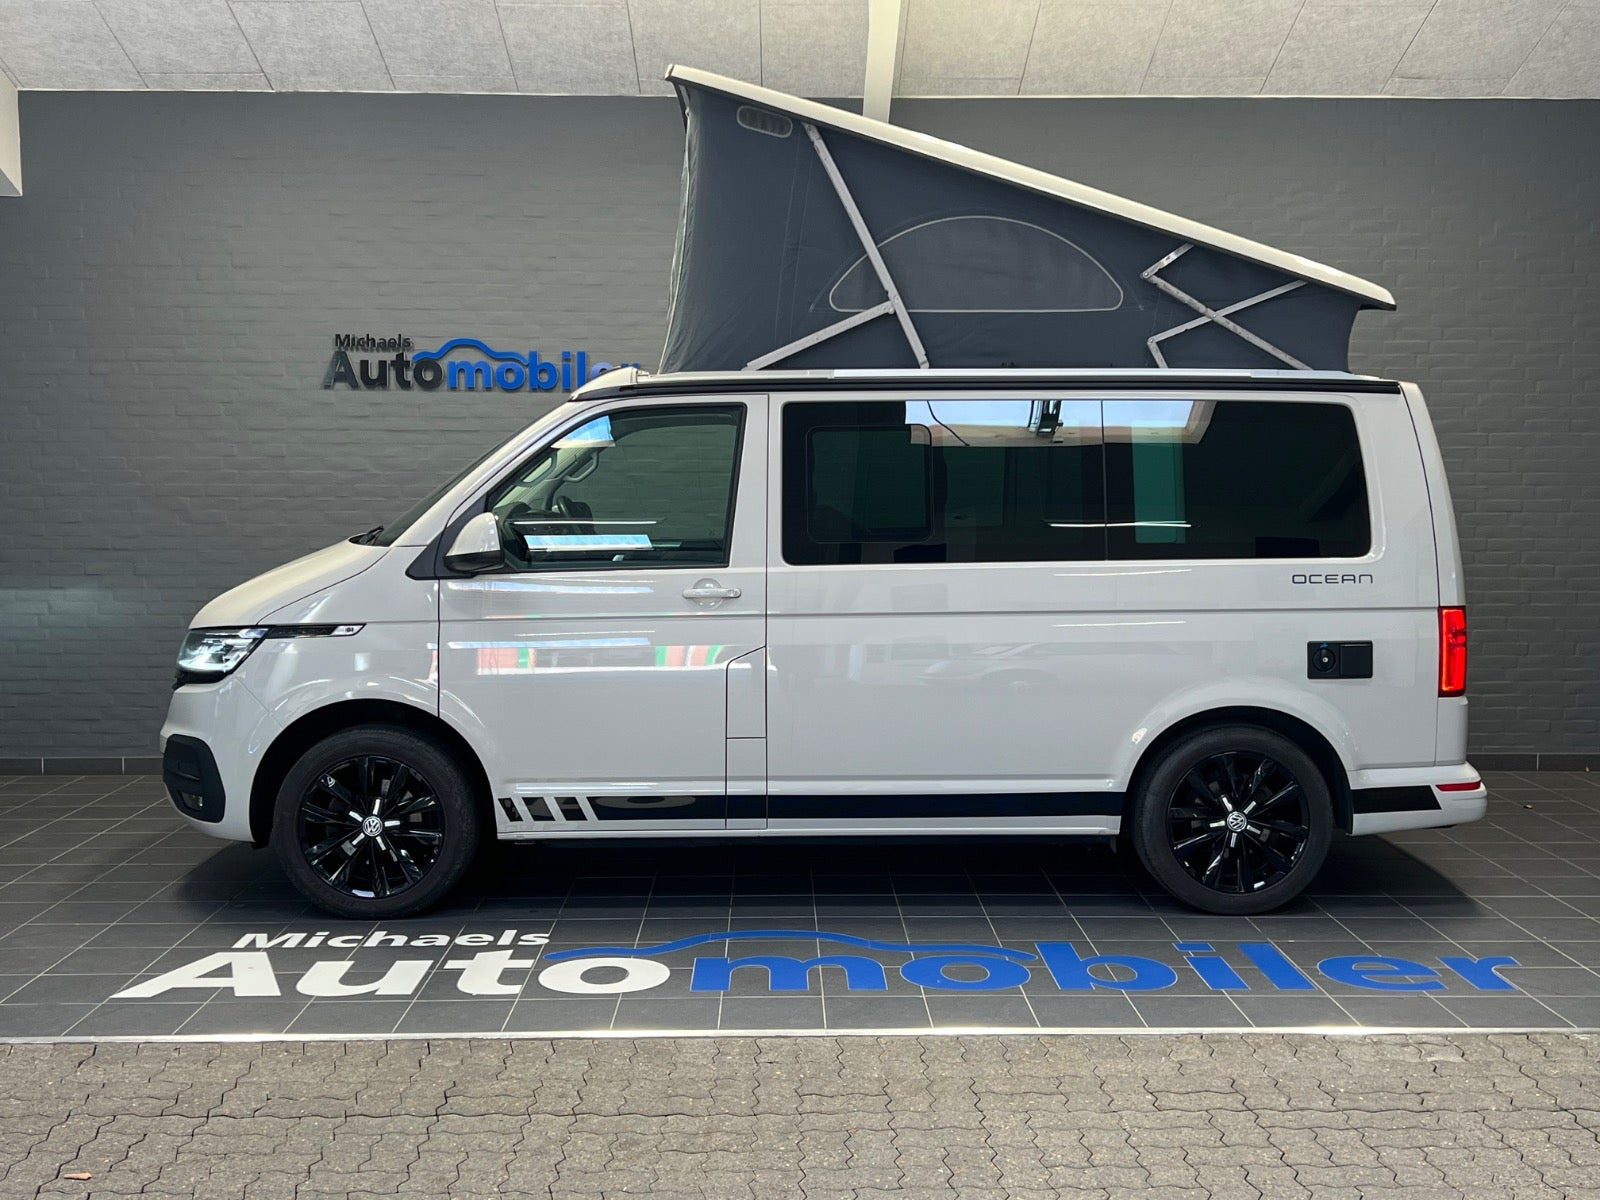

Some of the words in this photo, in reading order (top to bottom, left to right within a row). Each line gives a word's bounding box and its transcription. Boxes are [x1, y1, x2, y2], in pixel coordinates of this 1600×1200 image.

[335, 333, 412, 350] Michaels
[323, 351, 640, 391] Automobil
[1291, 573, 1374, 585] OCEAN
[231, 929, 551, 949] Michaels
[108, 942, 1523, 998] Automobiler
